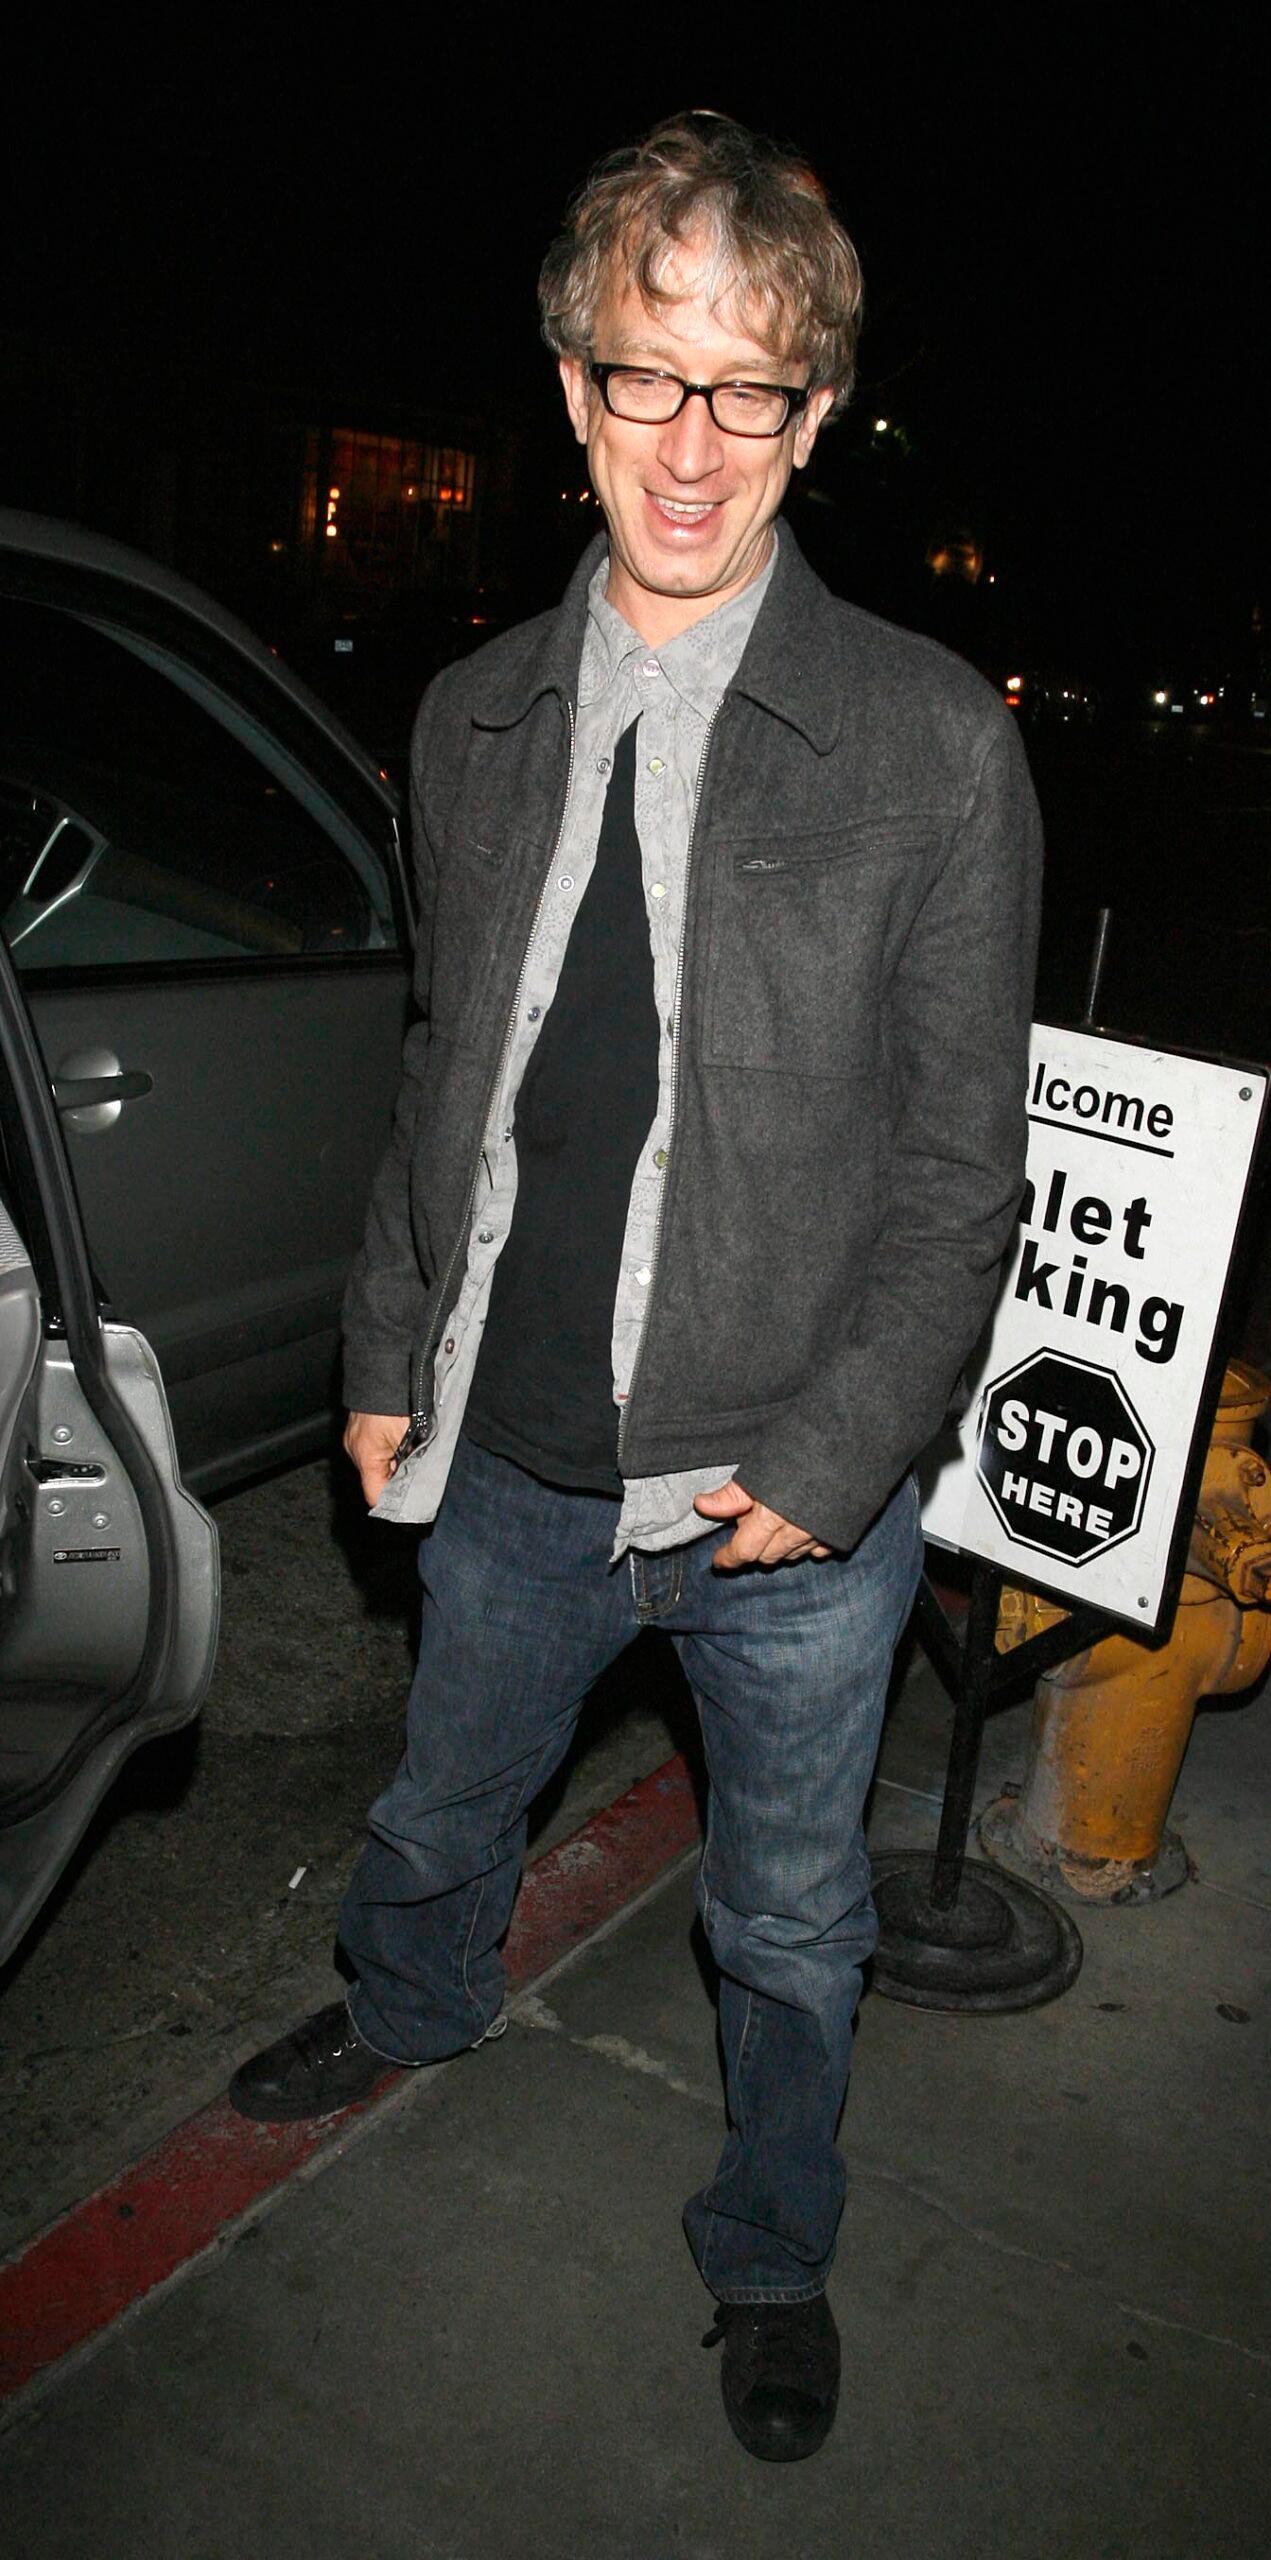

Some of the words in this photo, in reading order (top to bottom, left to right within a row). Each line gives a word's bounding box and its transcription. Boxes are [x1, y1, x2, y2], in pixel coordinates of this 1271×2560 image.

[1031, 1062, 1174, 1138] lcome
[1014, 1238, 1185, 1364] king
[997, 1399, 1141, 1490] STOP
[1001, 1470, 1114, 1541] HERE
